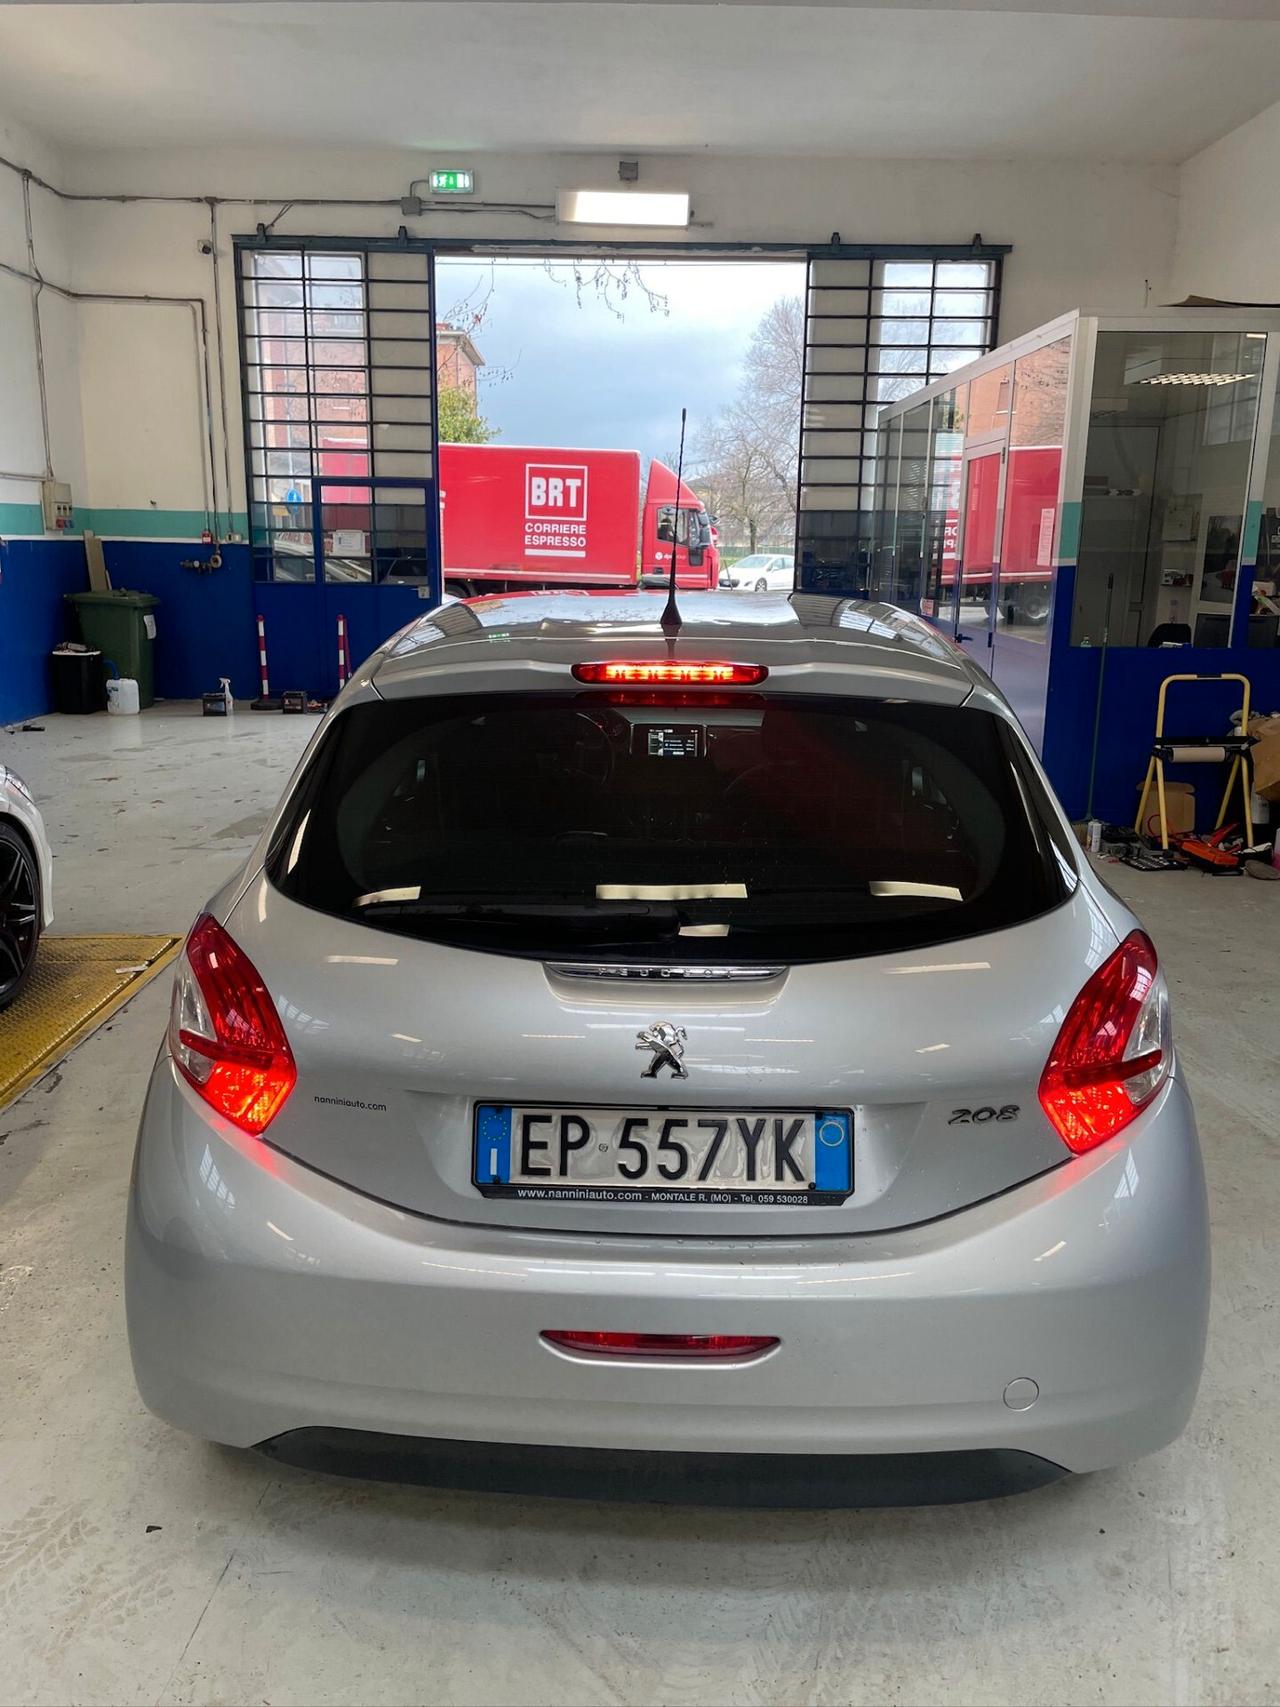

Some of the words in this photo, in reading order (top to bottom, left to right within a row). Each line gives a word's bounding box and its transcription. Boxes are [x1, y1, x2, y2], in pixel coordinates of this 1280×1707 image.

[531, 477, 582, 508] BRT
[524, 522, 587, 535] CORRIERE
[524, 535, 587, 547] ESPRESSO
[314, 1096, 387, 1112] nanniniauto.com
[948, 1104, 1021, 1126] 208
[520, 1115, 590, 1176] EP
[617, 1117, 805, 1181] 557YK
[517, 1188, 642, 1201] www.nanniniauto.com
[651, 1192, 696, 1202] MONTALE
[698, 1193, 708, 1202] R.
[710, 1193, 732, 1203] (MO)
[758, 1194, 774, 1203] 059
[776, 1195, 808, 1204] 530028
